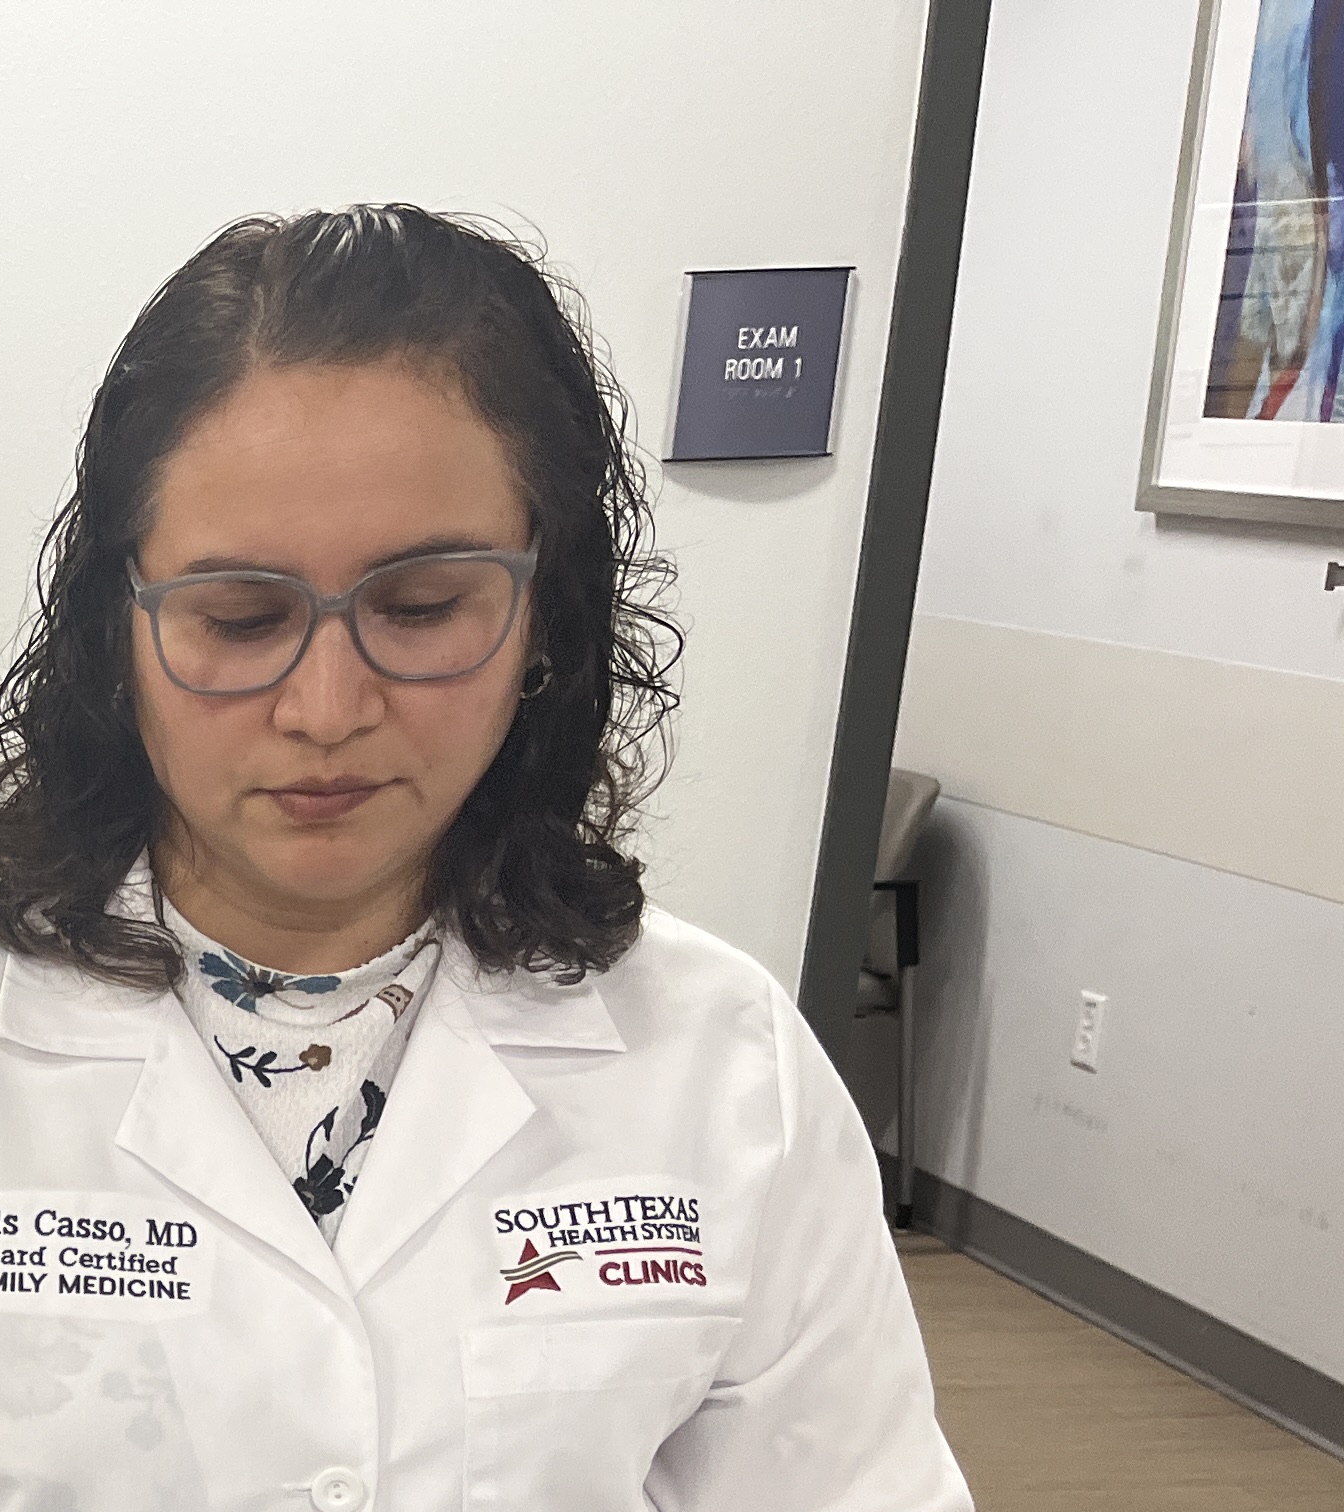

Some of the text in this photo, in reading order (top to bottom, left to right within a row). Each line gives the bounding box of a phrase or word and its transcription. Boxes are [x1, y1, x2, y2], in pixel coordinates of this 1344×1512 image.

[737, 325, 799, 349] EXAM
[724, 356, 803, 380] ROOM 1
[494, 1194, 700, 1234] SOUTH TEXAS
[34, 1209, 132, 1250] Casso,
[145, 1218, 198, 1248] MD
[547, 1222, 701, 1248] HEALTH SYSTEM
[58, 1247, 179, 1275] Certified
[598, 1259, 708, 1287] CLINICS
[58, 1273, 192, 1300] MEDICINE
